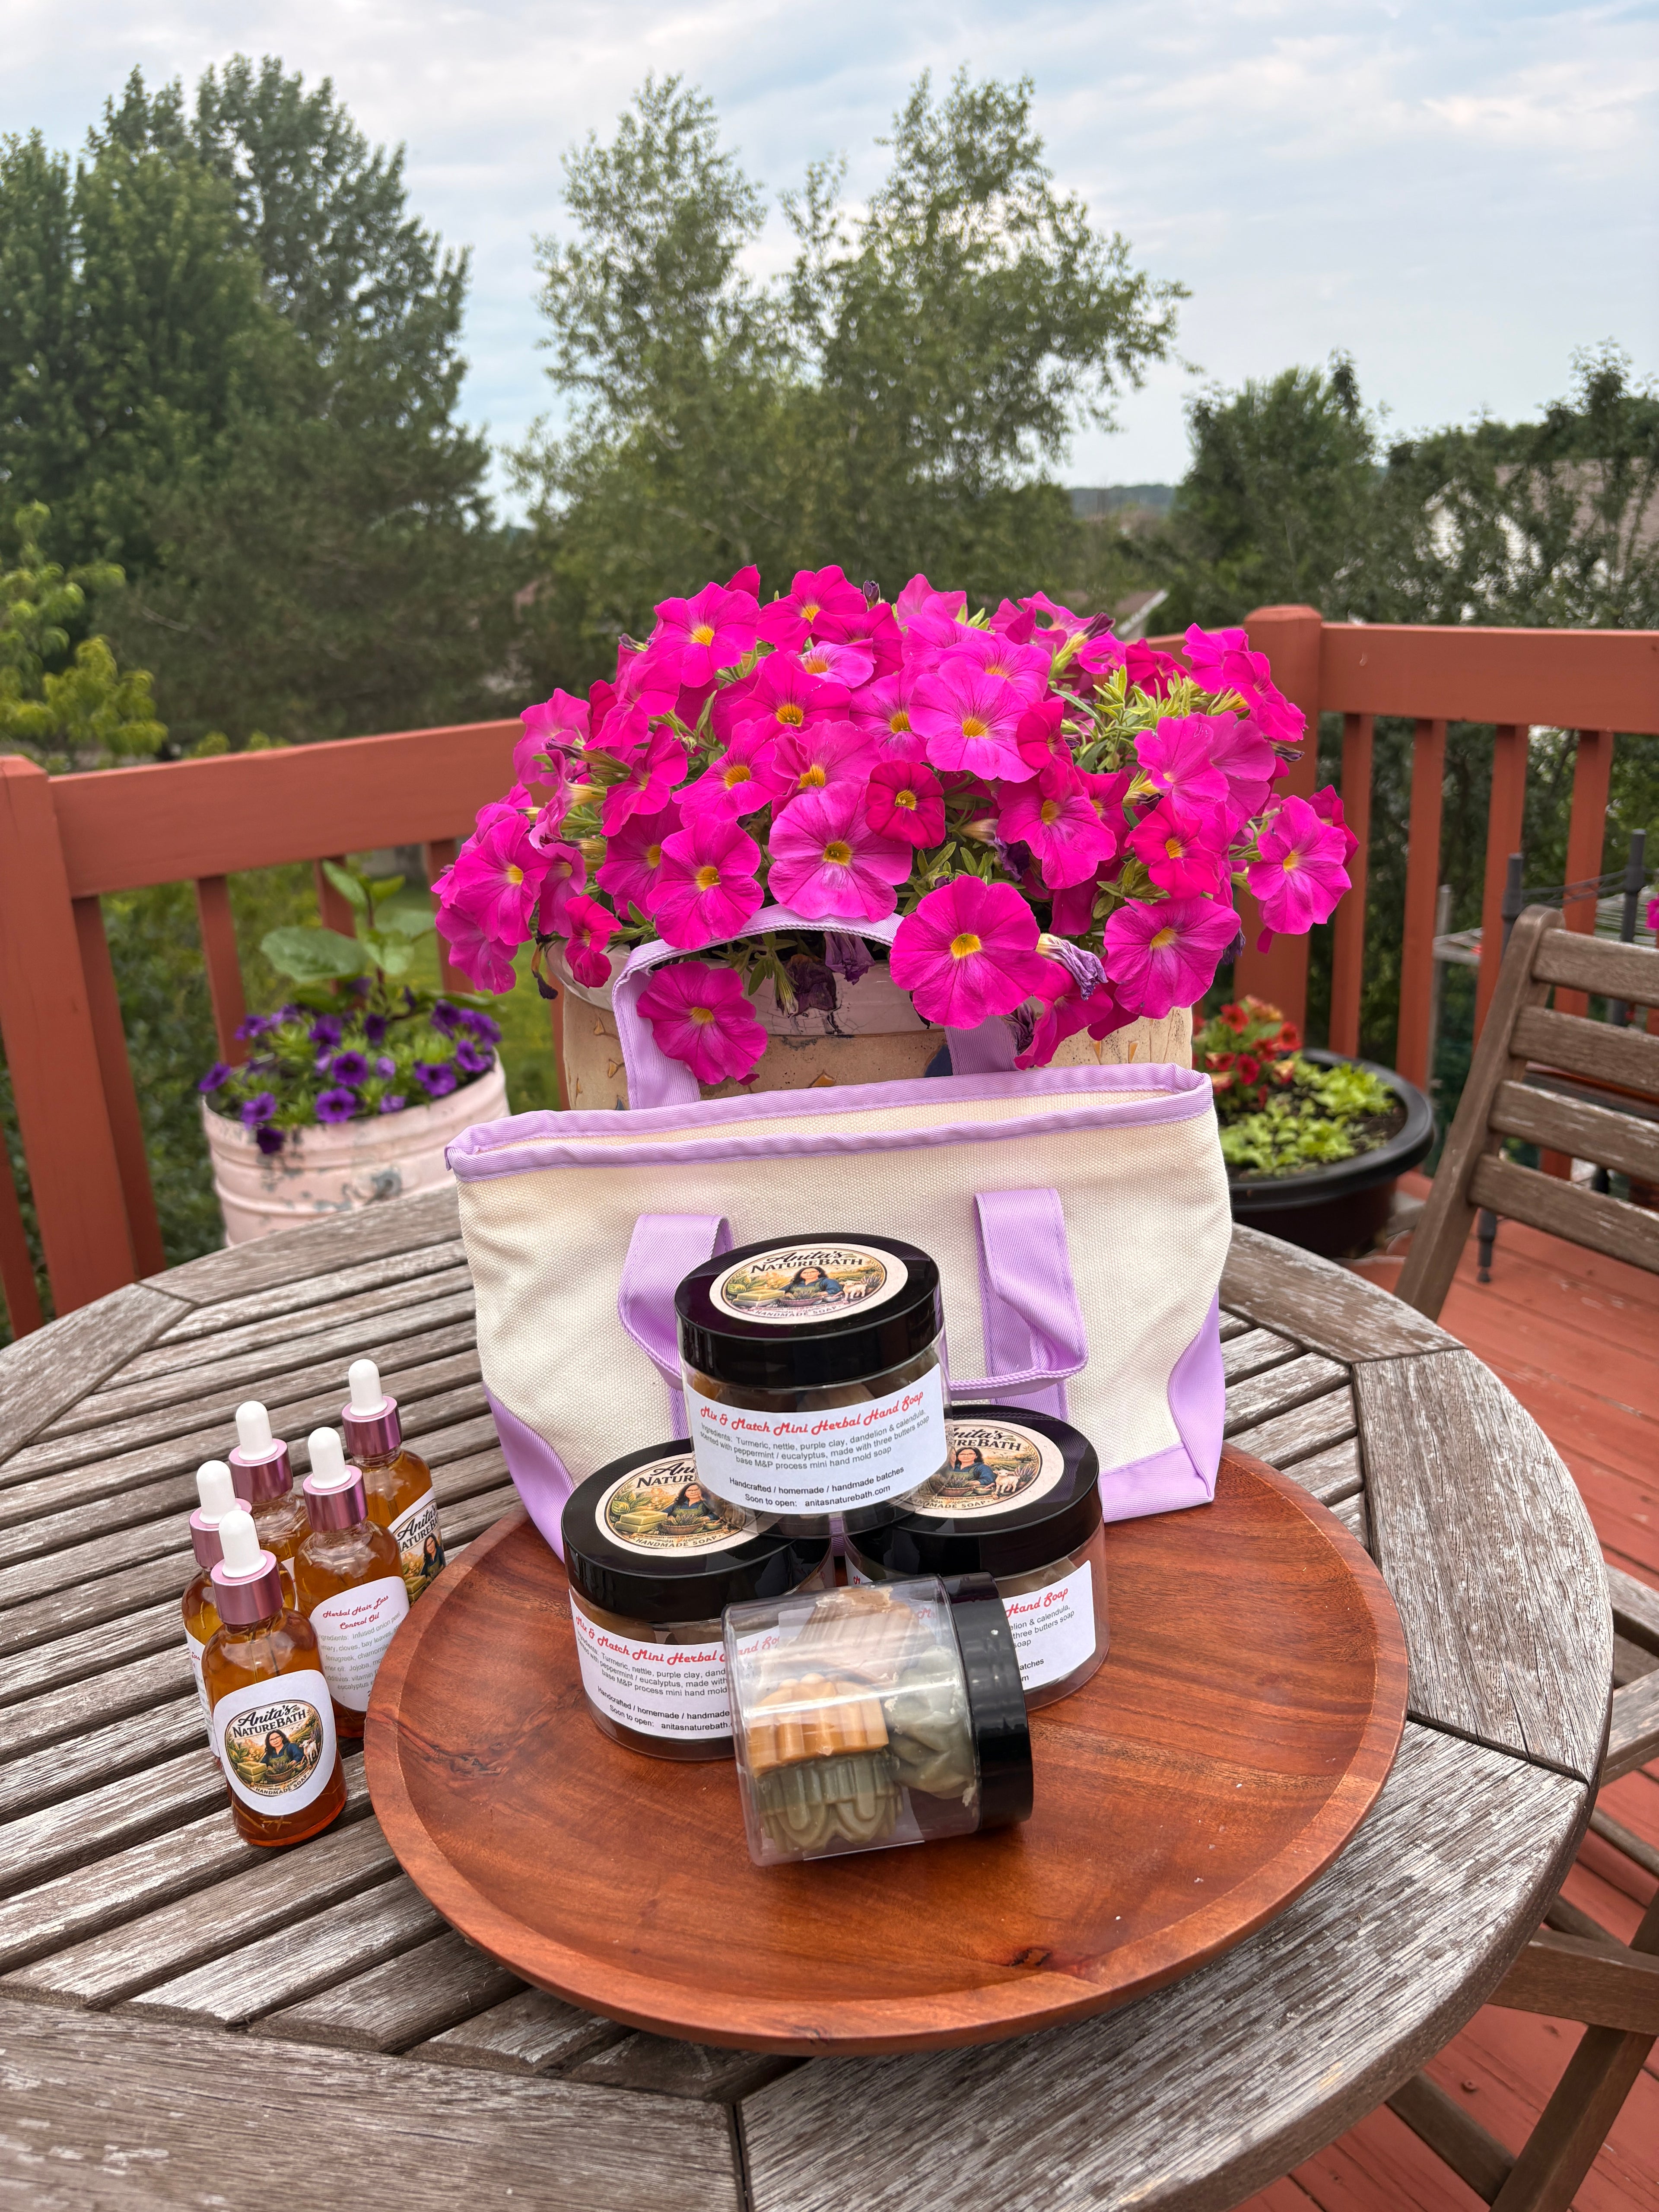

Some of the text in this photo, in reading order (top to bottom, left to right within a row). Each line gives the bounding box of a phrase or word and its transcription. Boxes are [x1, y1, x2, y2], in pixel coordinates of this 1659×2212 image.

[751, 1259, 863, 1273] NATUREBATH
[763, 1251, 854, 1263] Anita's
[813, 1306, 837, 1316] SOAP
[700, 1392, 923, 1436] Mix & Match Mini Herbal Hand Soap
[700, 1432, 719, 1446] scented
[720, 1442, 732, 1451] with
[734, 1447, 774, 1459] peppermint
[781, 1452, 828, 1461] eucalyptus,
[831, 1447, 853, 1457] made
[856, 1442, 871, 1452] with
[874, 1437, 892, 1447] three
[894, 1426, 915, 1440] butters
[917, 1415, 929, 1428] soap
[702, 1422, 732, 1442] Ingredients:
[736, 1437, 770, 1450] Turmeric,
[773, 1442, 798, 1451] nettle,
[800, 1441, 826, 1451] purple
[829, 1439, 848, 1448] clay,
[850, 1427, 887, 1443] dandelion
[896, 1409, 926, 1429] calendula,
[953, 1427, 1013, 1439] nita's
[953, 1439, 1021, 1451] REBATH
[736, 1446, 891, 1470] base M&P process mini hand mold soap
[636, 1475, 696, 1488] NATUR
[729, 1477, 771, 1493] Handcrafted
[779, 1486, 824, 1494] homemade
[832, 1478, 874, 1492] handmade
[876, 1466, 904, 1482] batches
[745, 1494, 764, 1504] Soon
[805, 1485, 890, 1507] anitasnaturebath.com
[636, 1535, 717, 1548] HANDMADE SOAP
[323, 1595, 388, 1618] Herbal Hair Loss
[1005, 1588, 1068, 1618] Hand Soap
[340, 1612, 379, 1630] Control Oil
[1010, 1622, 1027, 1630] elion
[1037, 1605, 1070, 1623] calendula,
[1013, 1611, 1074, 1639] three butters soap
[353, 1627, 375, 1639] Infused
[376, 1620, 391, 1632] onion
[588, 1628, 595, 1639] &
[597, 1636, 630, 1655] Match
[632, 1649, 664, 1661] Mini
[667, 1650, 717, 1665] Herbal
[1014, 1640, 1031, 1648] soap
[349, 1664, 371, 1672] Jojoba,
[600, 1661, 633, 1680] peppermint
[640, 1677, 683, 1688] eucalyptus,
[686, 1679, 709, 1687] made
[601, 1652, 630, 1671] Turmeric,
[632, 1667, 654, 1677] nettle,
[657, 1670, 681, 1679] purple
[1020, 1659, 1044, 1670] atches
[602, 1669, 615, 1681] base
[617, 1677, 632, 1686] M&P
[635, 1684, 663, 1695] process
[708, 1687, 727, 1695] mold
[598, 1686, 631, 1710] Handcrafted
[638, 1706, 680, 1719] homemade
[687, 1710, 730, 1719] handmade
[232, 1709, 306, 1738] NATUREBATH
[238, 1705, 297, 1726] Anita's
[610, 1705, 625, 1717] Soon
[635, 1717, 654, 1727] open:
[661, 1721, 732, 1731] anitasnaturebath.
[256, 1786, 292, 1795] HANDMADE
[294, 1774, 308, 1788] SOAP
